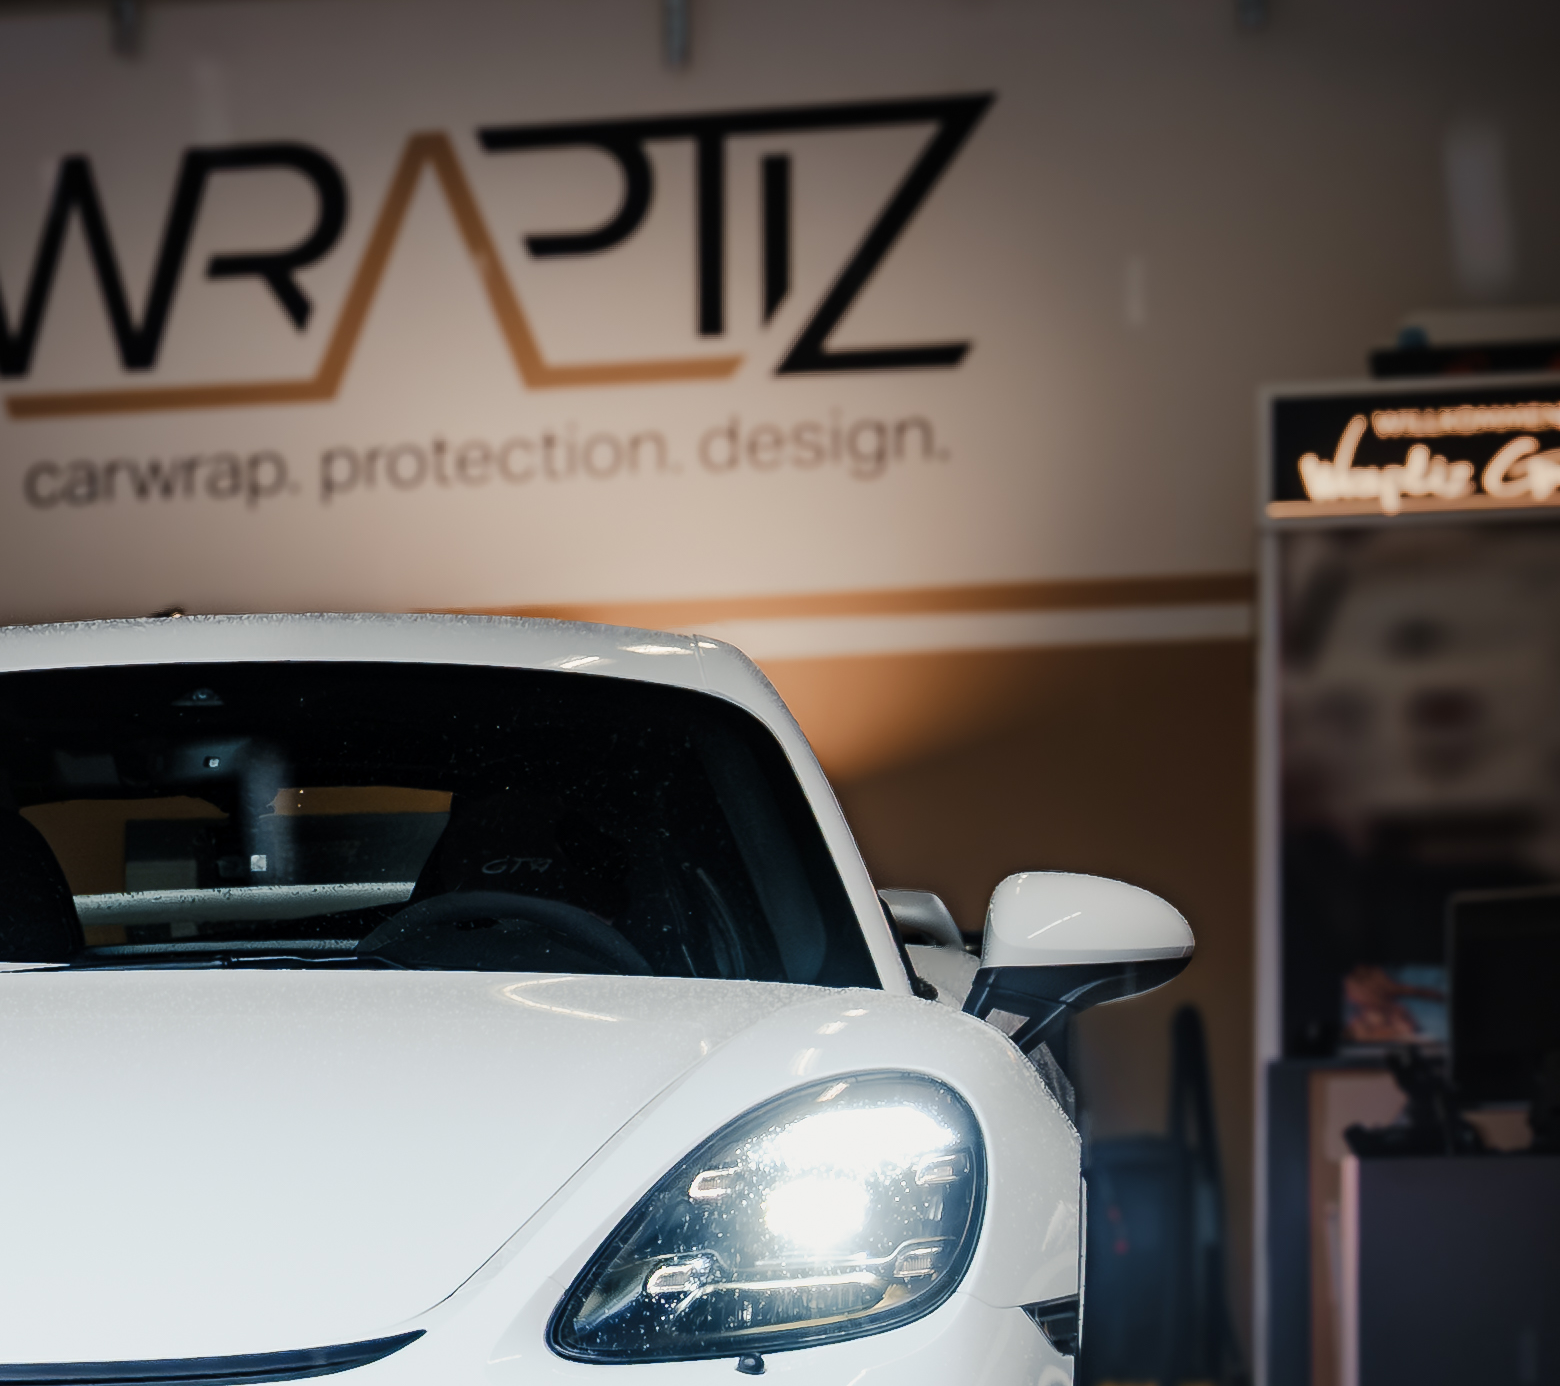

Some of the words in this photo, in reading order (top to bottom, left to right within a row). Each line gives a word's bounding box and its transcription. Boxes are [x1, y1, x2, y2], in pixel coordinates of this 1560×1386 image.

[22, 445, 300, 510] carwrap.
[320, 421, 684, 504] protection.
[697, 408, 954, 482] design.
